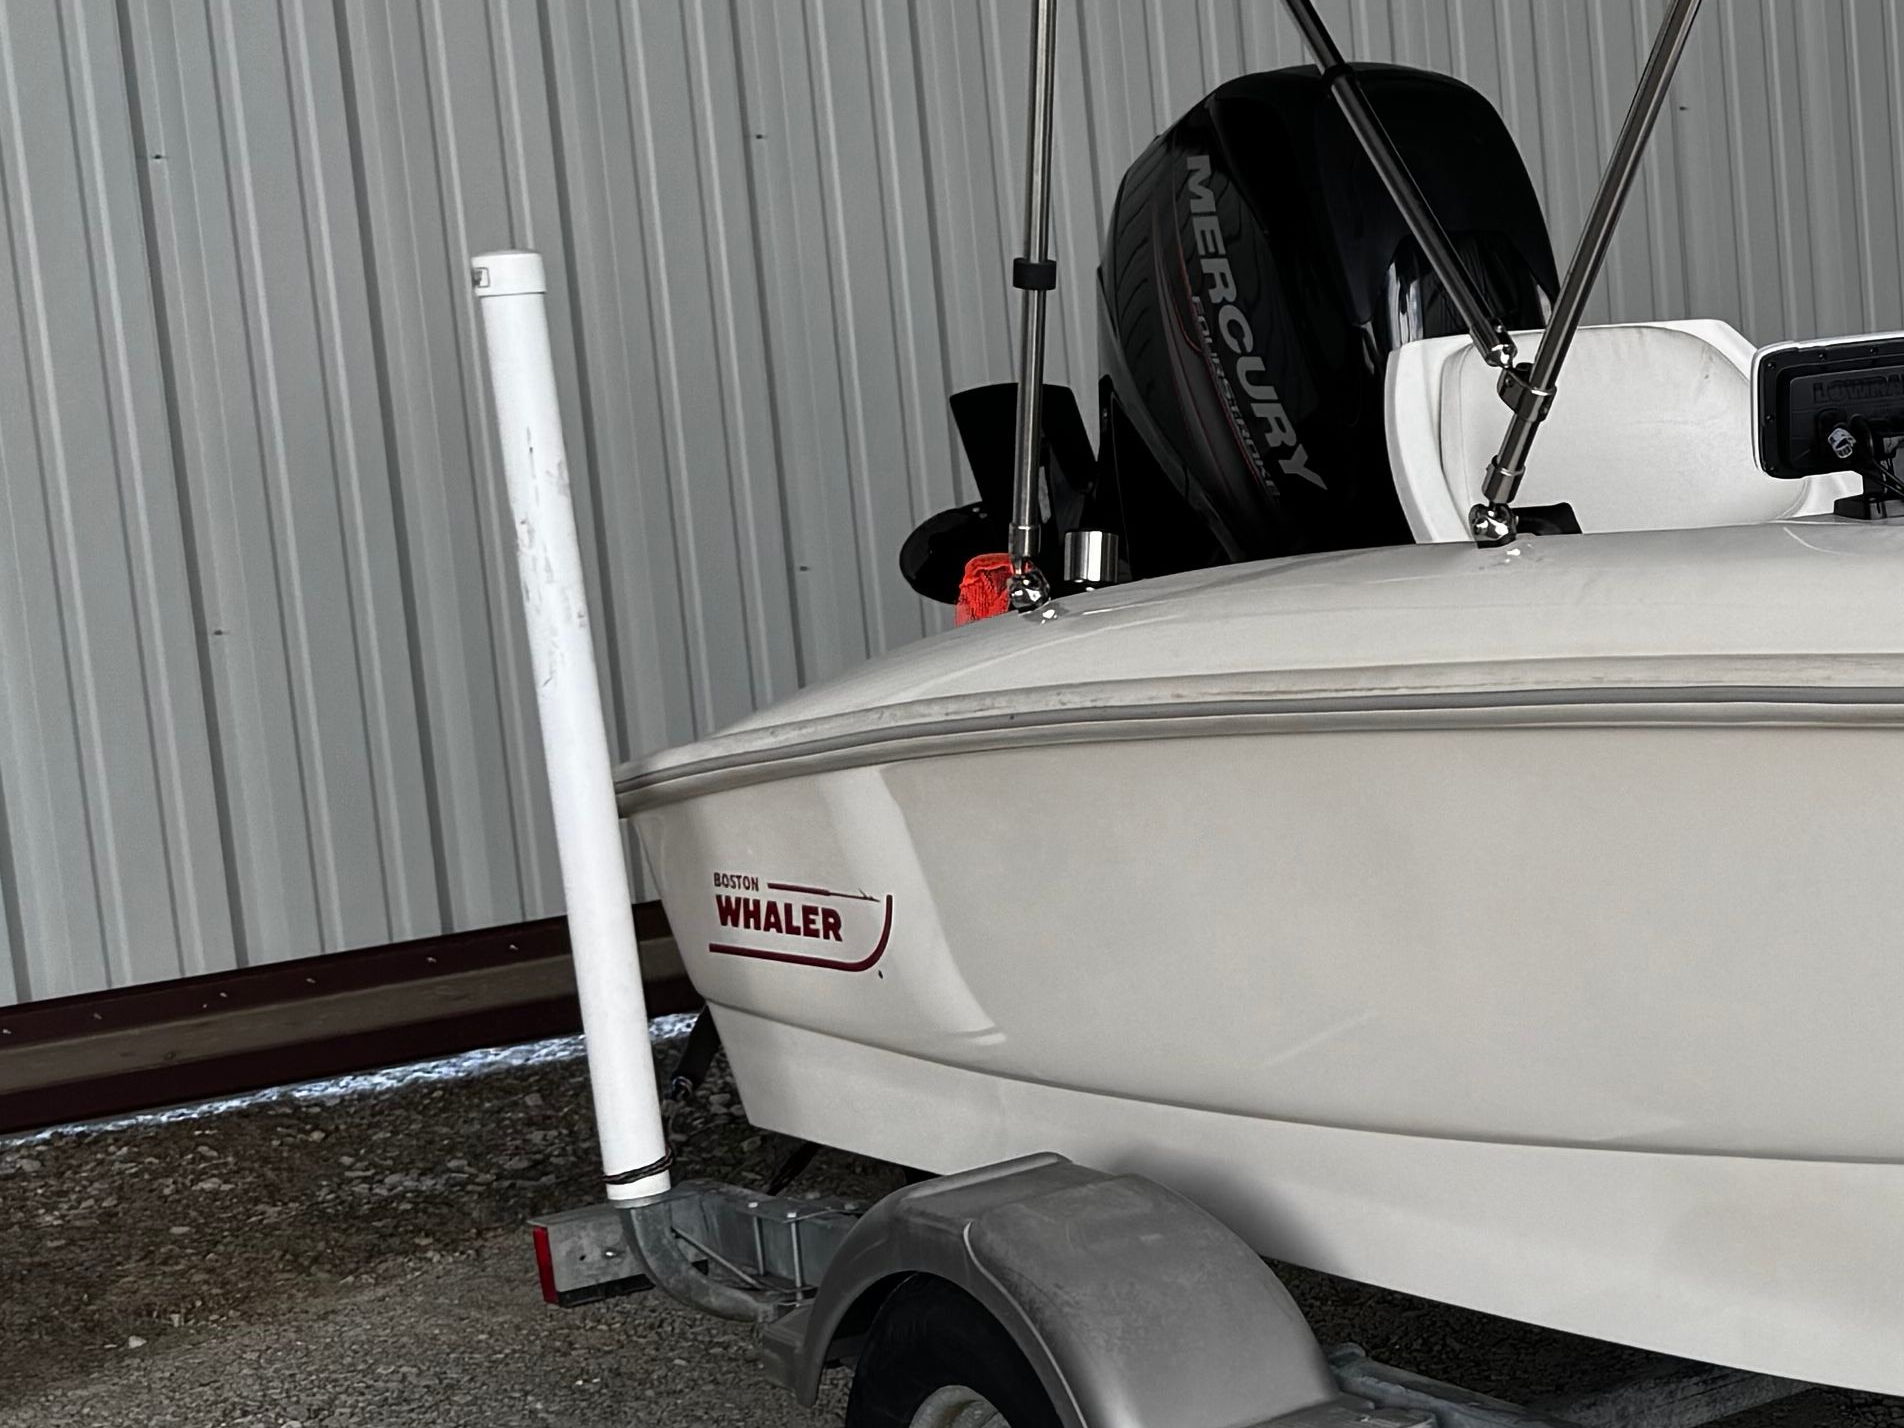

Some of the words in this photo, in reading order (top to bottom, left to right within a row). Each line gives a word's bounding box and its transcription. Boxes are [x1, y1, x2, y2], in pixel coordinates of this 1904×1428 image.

[1184, 153, 1328, 491] MERCURY
[713, 872, 760, 892] BOSTON
[715, 894, 843, 942] WHALER
